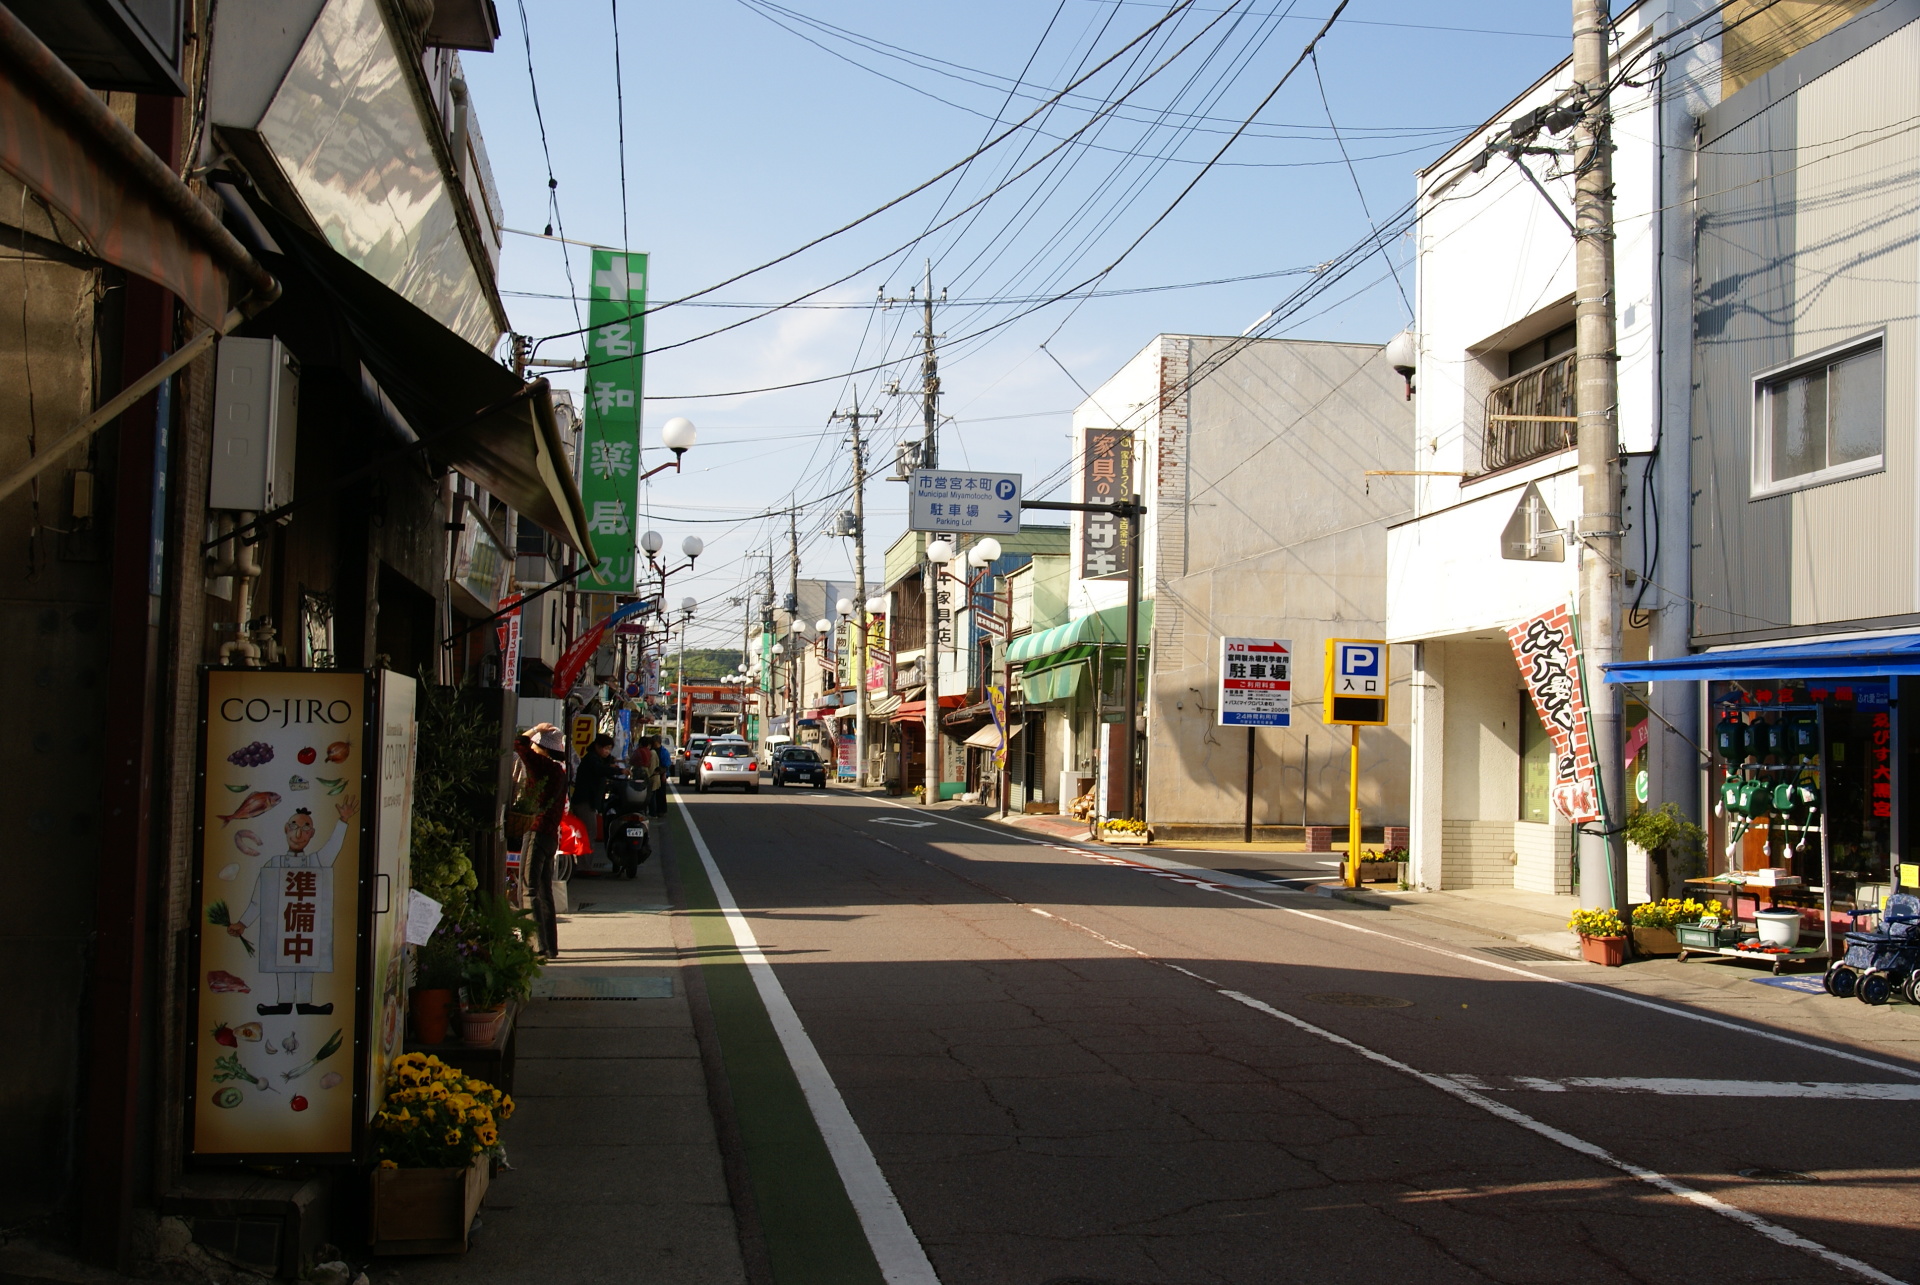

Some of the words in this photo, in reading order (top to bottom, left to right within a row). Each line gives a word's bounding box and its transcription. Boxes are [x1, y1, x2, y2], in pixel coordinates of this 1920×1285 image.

[589, 324, 637, 535] 名和薬局
[919, 476, 992, 492] 市営宮本町
[918, 491, 949, 500] Municipal
[950, 492, 993, 501] Miyamotocho
[1086, 433, 1117, 575] 家具のササキ
[930, 503, 980, 518] 駐車場
[936, 518, 957, 528] Parking
[958, 518, 973, 527] Lot
[1228, 643, 1245, 652] 入口
[1227, 654, 1289, 664] 富岡製糸場見学者用
[1346, 648, 1375, 673] P
[1229, 663, 1287, 680] 駐車場
[1343, 679, 1376, 692] 入口
[220, 697, 352, 729] CO-JIRO
[282, 870, 317, 965] 準備中
